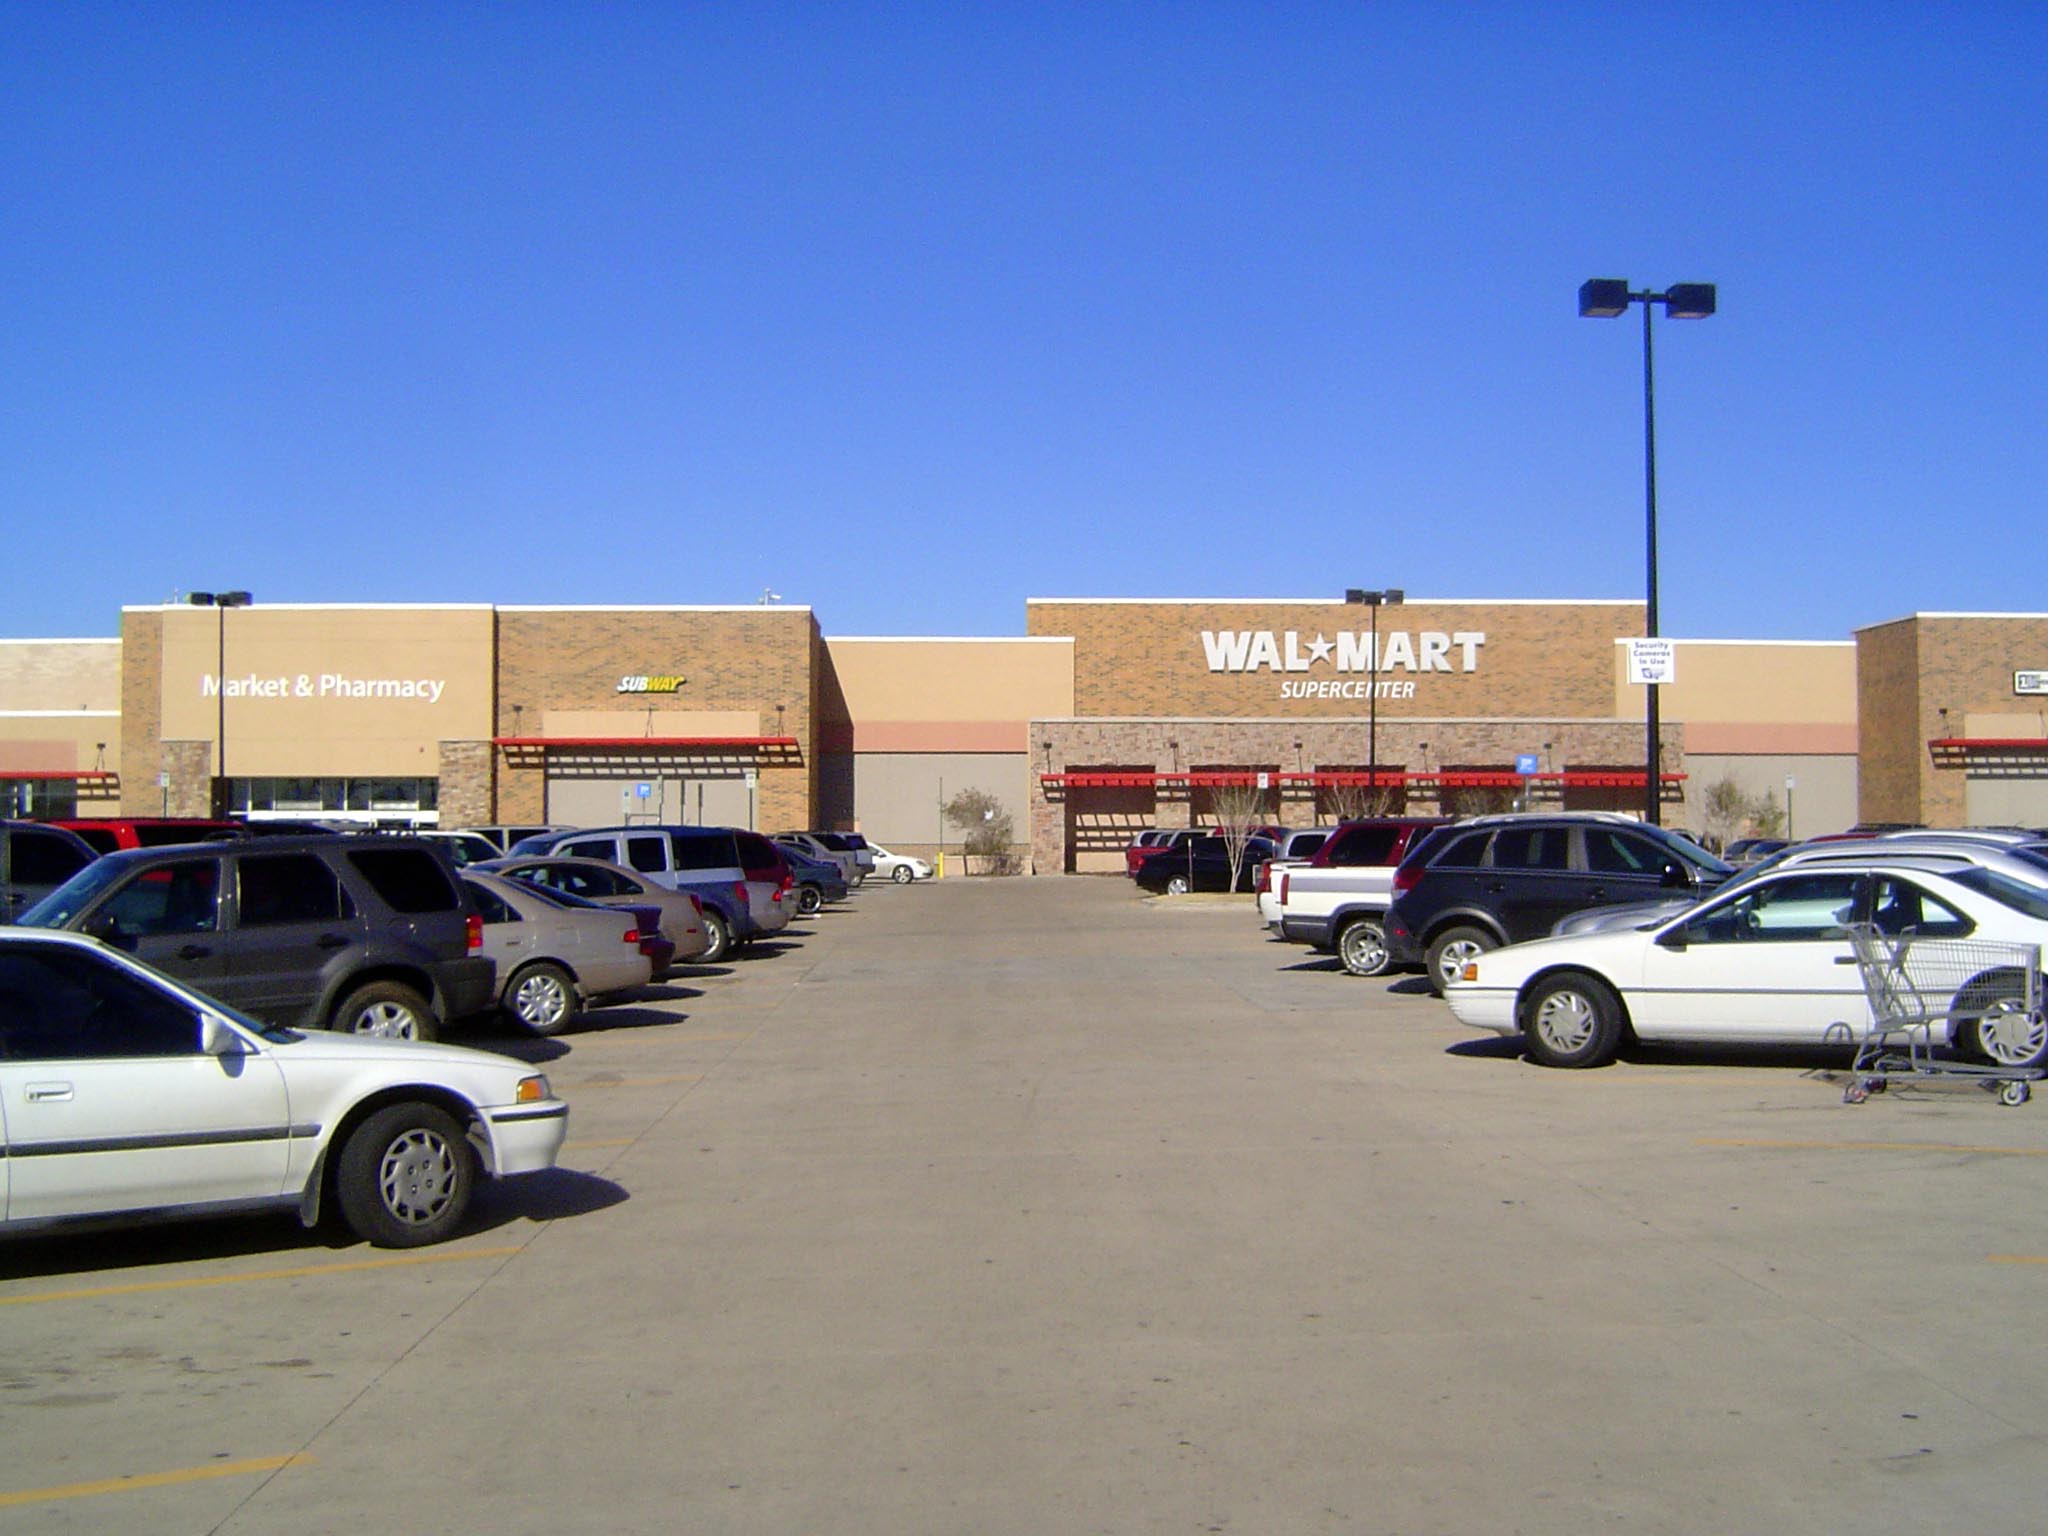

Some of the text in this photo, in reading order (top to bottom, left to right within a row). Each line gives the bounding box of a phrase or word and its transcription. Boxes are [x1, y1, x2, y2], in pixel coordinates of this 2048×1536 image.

[203, 674, 444, 703] Market & Pharmacy
[617, 676, 685, 692] SUBWAY
[1280, 681, 1415, 699] SUPERCENTER
